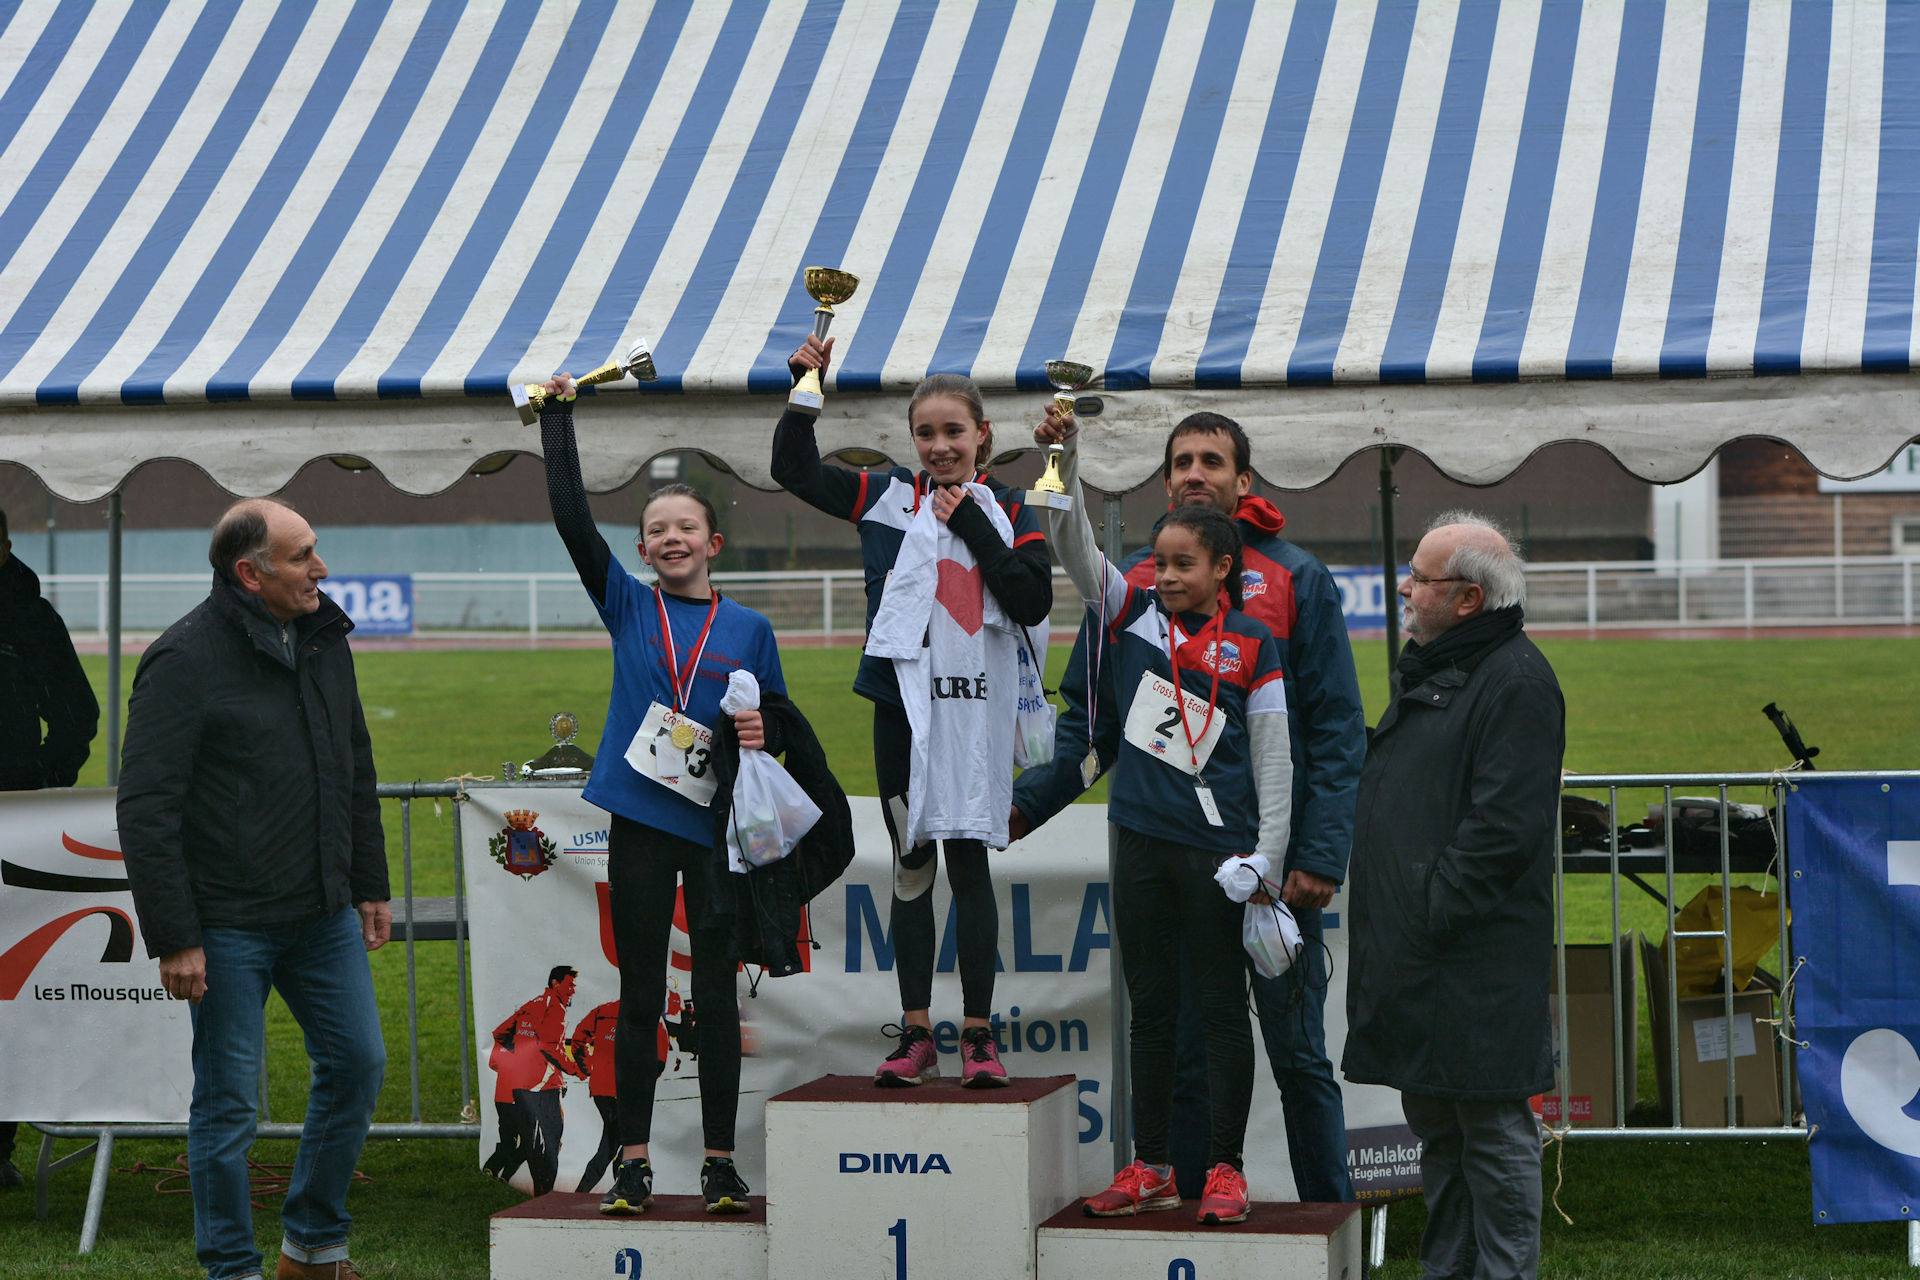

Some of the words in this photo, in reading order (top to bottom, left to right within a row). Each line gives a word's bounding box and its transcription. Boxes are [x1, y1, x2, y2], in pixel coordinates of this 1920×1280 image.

[930, 671, 988, 701] URÉ
[1152, 680, 1174, 699] Cross
[1154, 706, 1182, 740] 2
[573, 829, 609, 847] USM
[574, 855, 596, 867] Union
[35, 984, 65, 1000] les
[901, 1005, 1089, 1054] etion
[839, 1152, 953, 1175] DIMA
[1354, 1166, 1392, 1182] Eugène
[887, 1218, 907, 1280] 1
